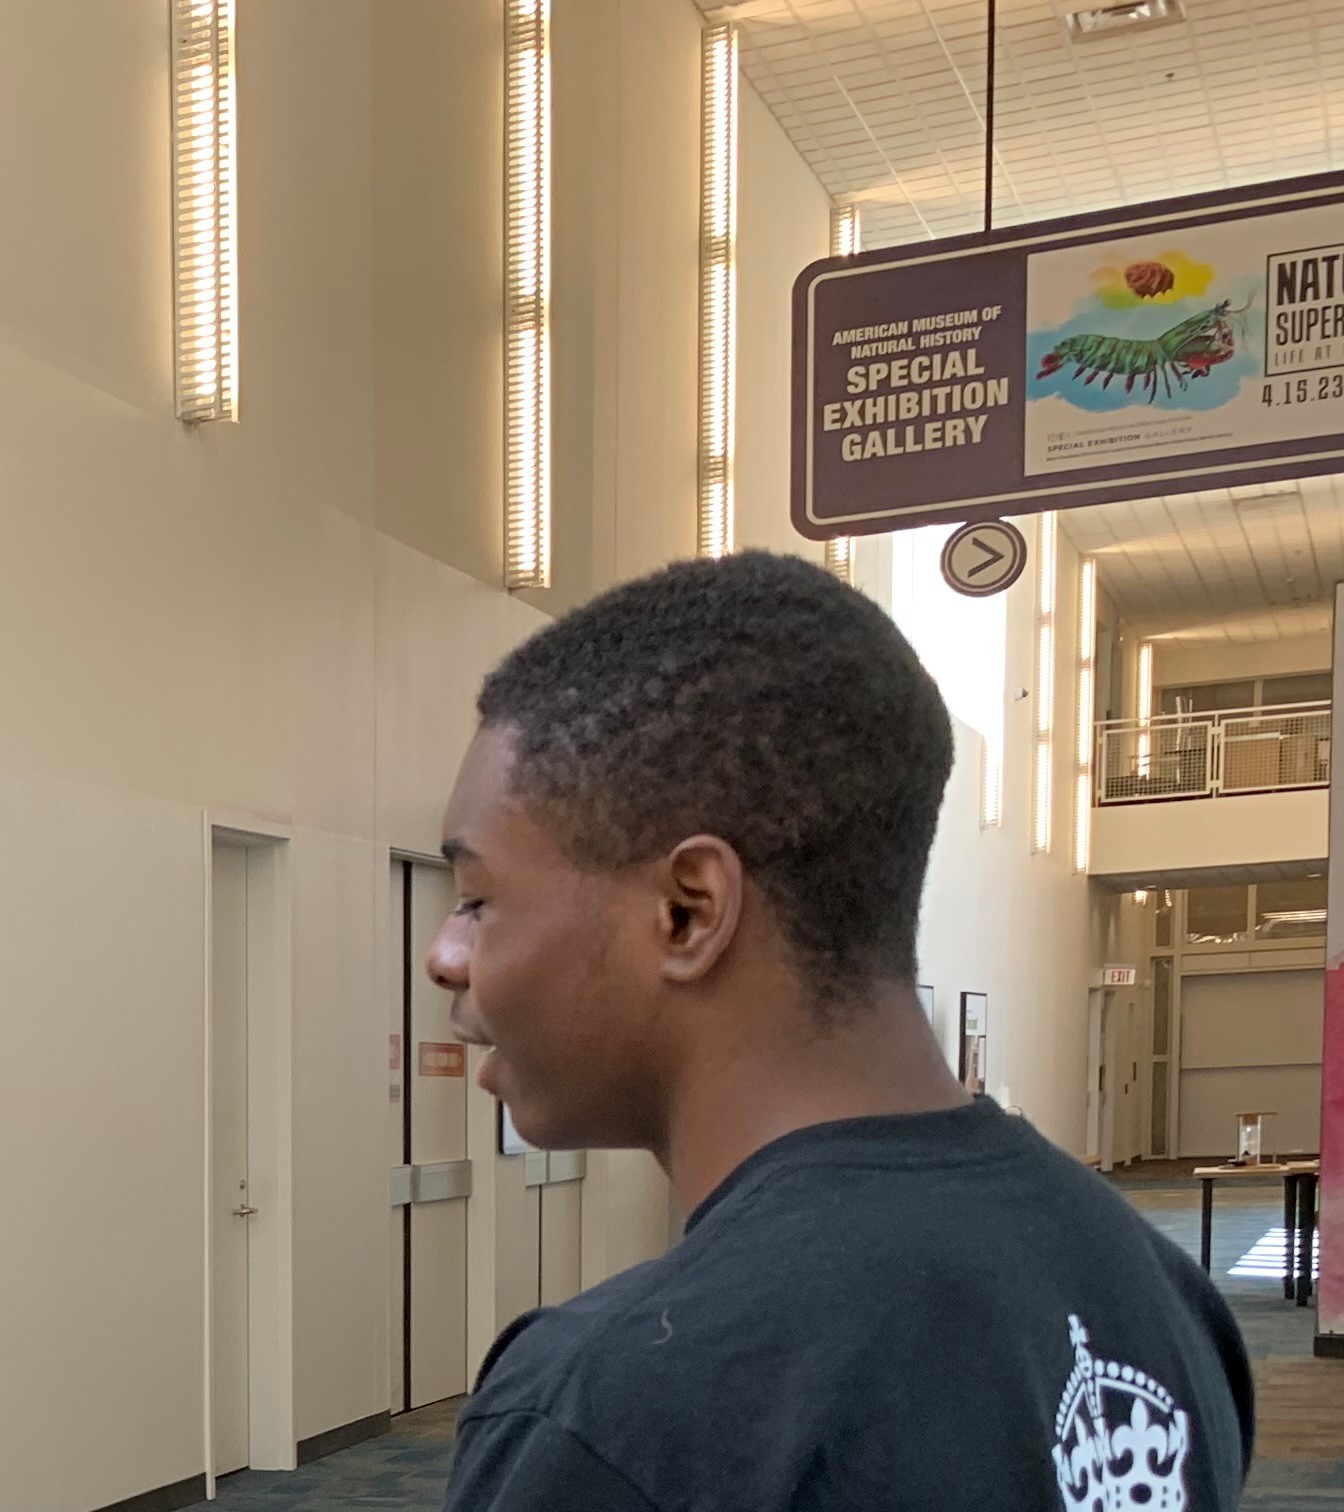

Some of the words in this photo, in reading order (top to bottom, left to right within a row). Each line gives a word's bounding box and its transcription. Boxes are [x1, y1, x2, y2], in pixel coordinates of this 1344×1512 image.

[1276, 253, 1343, 306] NAT
[832, 321, 909, 346] AMERICAN
[912, 309, 978, 333] MUSEUM
[982, 305, 1002, 322] OF
[850, 339, 916, 360] NATURAL
[919, 326, 982, 350] HISTORY
[846, 348, 986, 395] SPECIAL
[1274, 347, 1305, 367] LIFE
[1314, 344, 1332, 361] AT
[823, 377, 1010, 432] EXHIBITION
[1262, 374, 1343, 408] 4.15.23
[841, 414, 989, 463] GALLERY
[1047, 442, 1085, 453] SPECIAL
[1087, 433, 1141, 448] EXHIBITION
